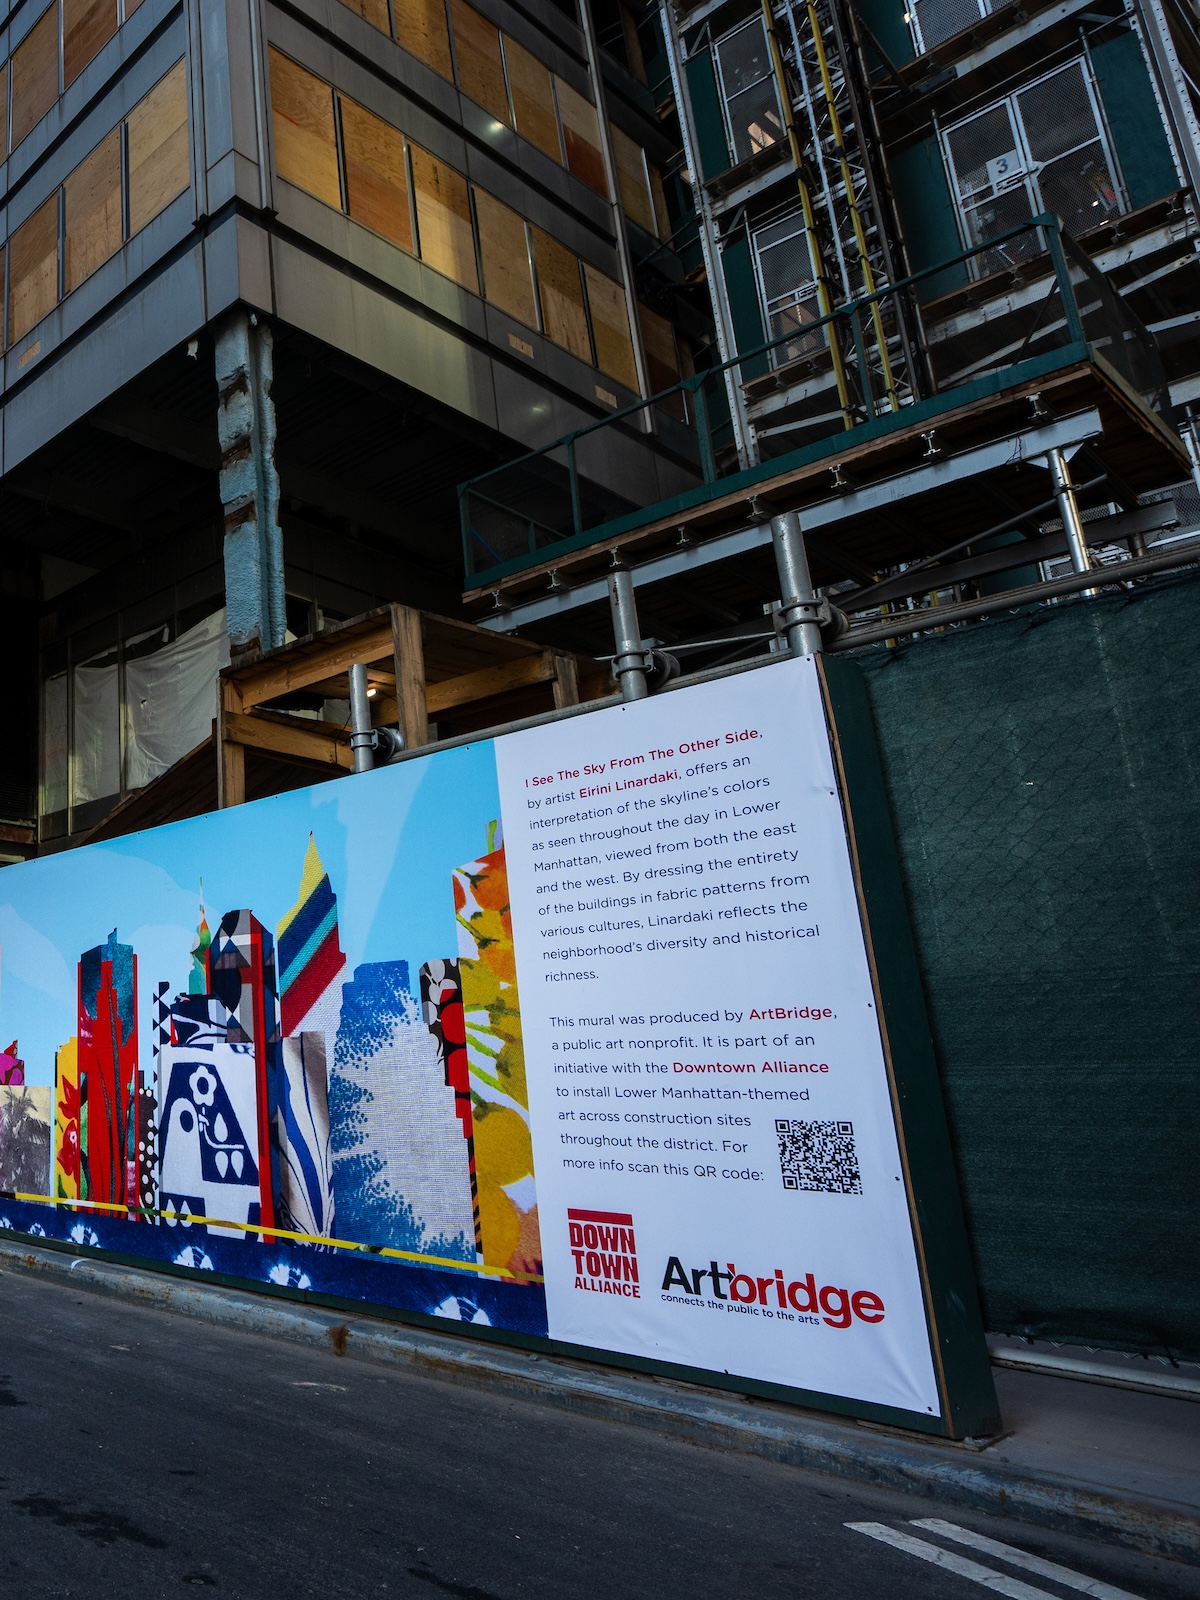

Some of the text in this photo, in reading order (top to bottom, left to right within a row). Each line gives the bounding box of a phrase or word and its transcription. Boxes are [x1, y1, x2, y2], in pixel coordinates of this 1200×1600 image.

[996, 158, 1008, 174] 3
[526, 729, 762, 788] I See The Sky From The Other Side,
[528, 757, 750, 809] by artist Eirini Linardaki, offers an
[530, 778, 770, 829] interpretation of the skyline's colors
[532, 801, 780, 851] as seen throughout the day in Lower
[534, 823, 797, 872] Manhattan, viewed from both the east
[537, 850, 798, 894] and the west. By dressing the entirety
[539, 875, 809, 915] of the buildings in fabric patterns from
[541, 901, 807, 937] various cultures, Linardaki reflects the
[543, 925, 819, 960] neighborhood's diversity and historical
[545, 971, 598, 982] richness.
[549, 1006, 837, 1027] This mural was produced by ArtBridge,
[552, 1034, 814, 1052] a public art nonprofit. It is part of an
[554, 1061, 829, 1073] initiative with the Downtown Alliance
[556, 1086, 809, 1100] to install Lower Manhattan-themed
[559, 1110, 751, 1126] art across construction sites
[560, 1133, 748, 1152] throughout the district. For
[563, 1159, 764, 1181] more info scan this QR code:
[568, 1222, 637, 1255] DOWN
[571, 1249, 640, 1283] TOWN
[574, 1276, 641, 1299] ALLIANCE
[661, 1293, 820, 1326] connects the public to the arts
